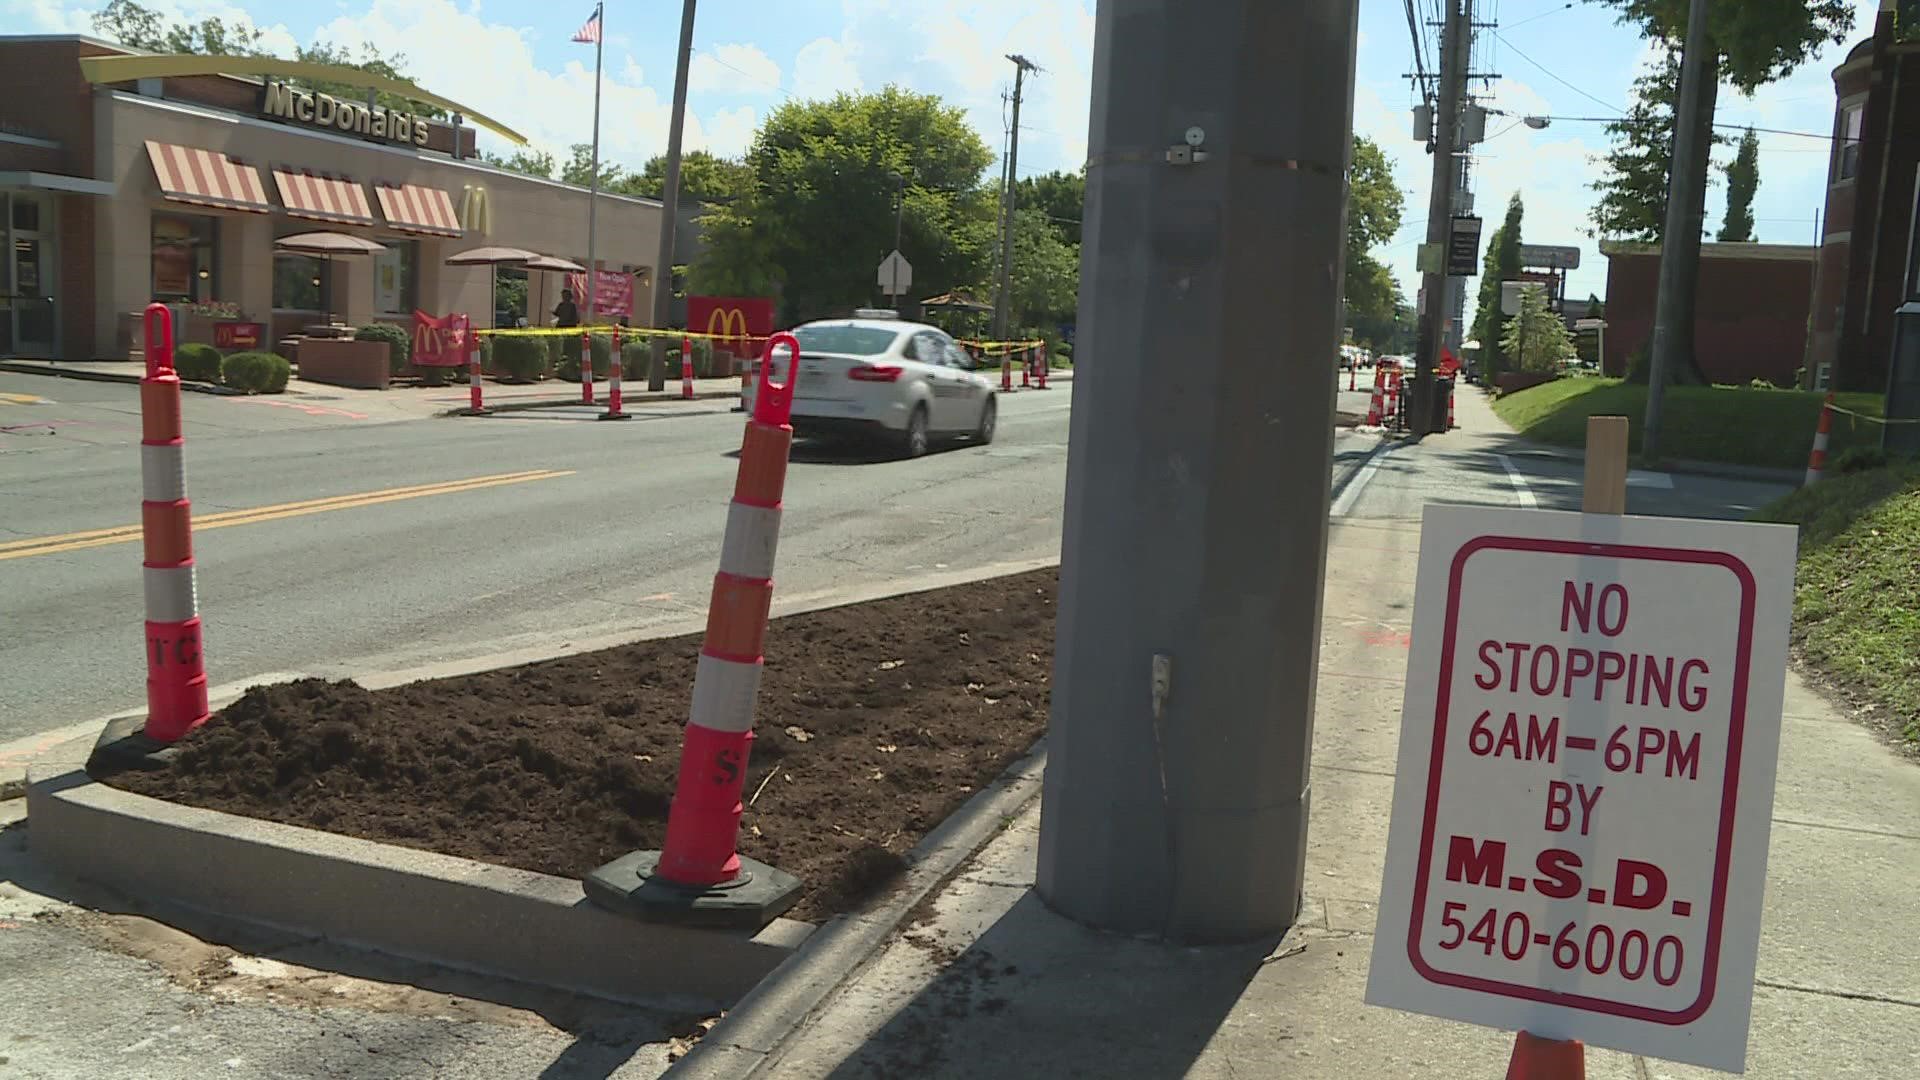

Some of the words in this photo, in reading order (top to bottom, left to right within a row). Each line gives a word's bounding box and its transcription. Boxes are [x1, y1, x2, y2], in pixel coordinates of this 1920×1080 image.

[264, 82, 429, 145] McDonald's
[1560, 581, 1629, 637] NO
[1474, 640, 1710, 712] STOPPING
[1544, 780, 1604, 836] BY
[1445, 834, 1692, 918] M.S.D.
[1438, 900, 1684, 987] 540-6000
